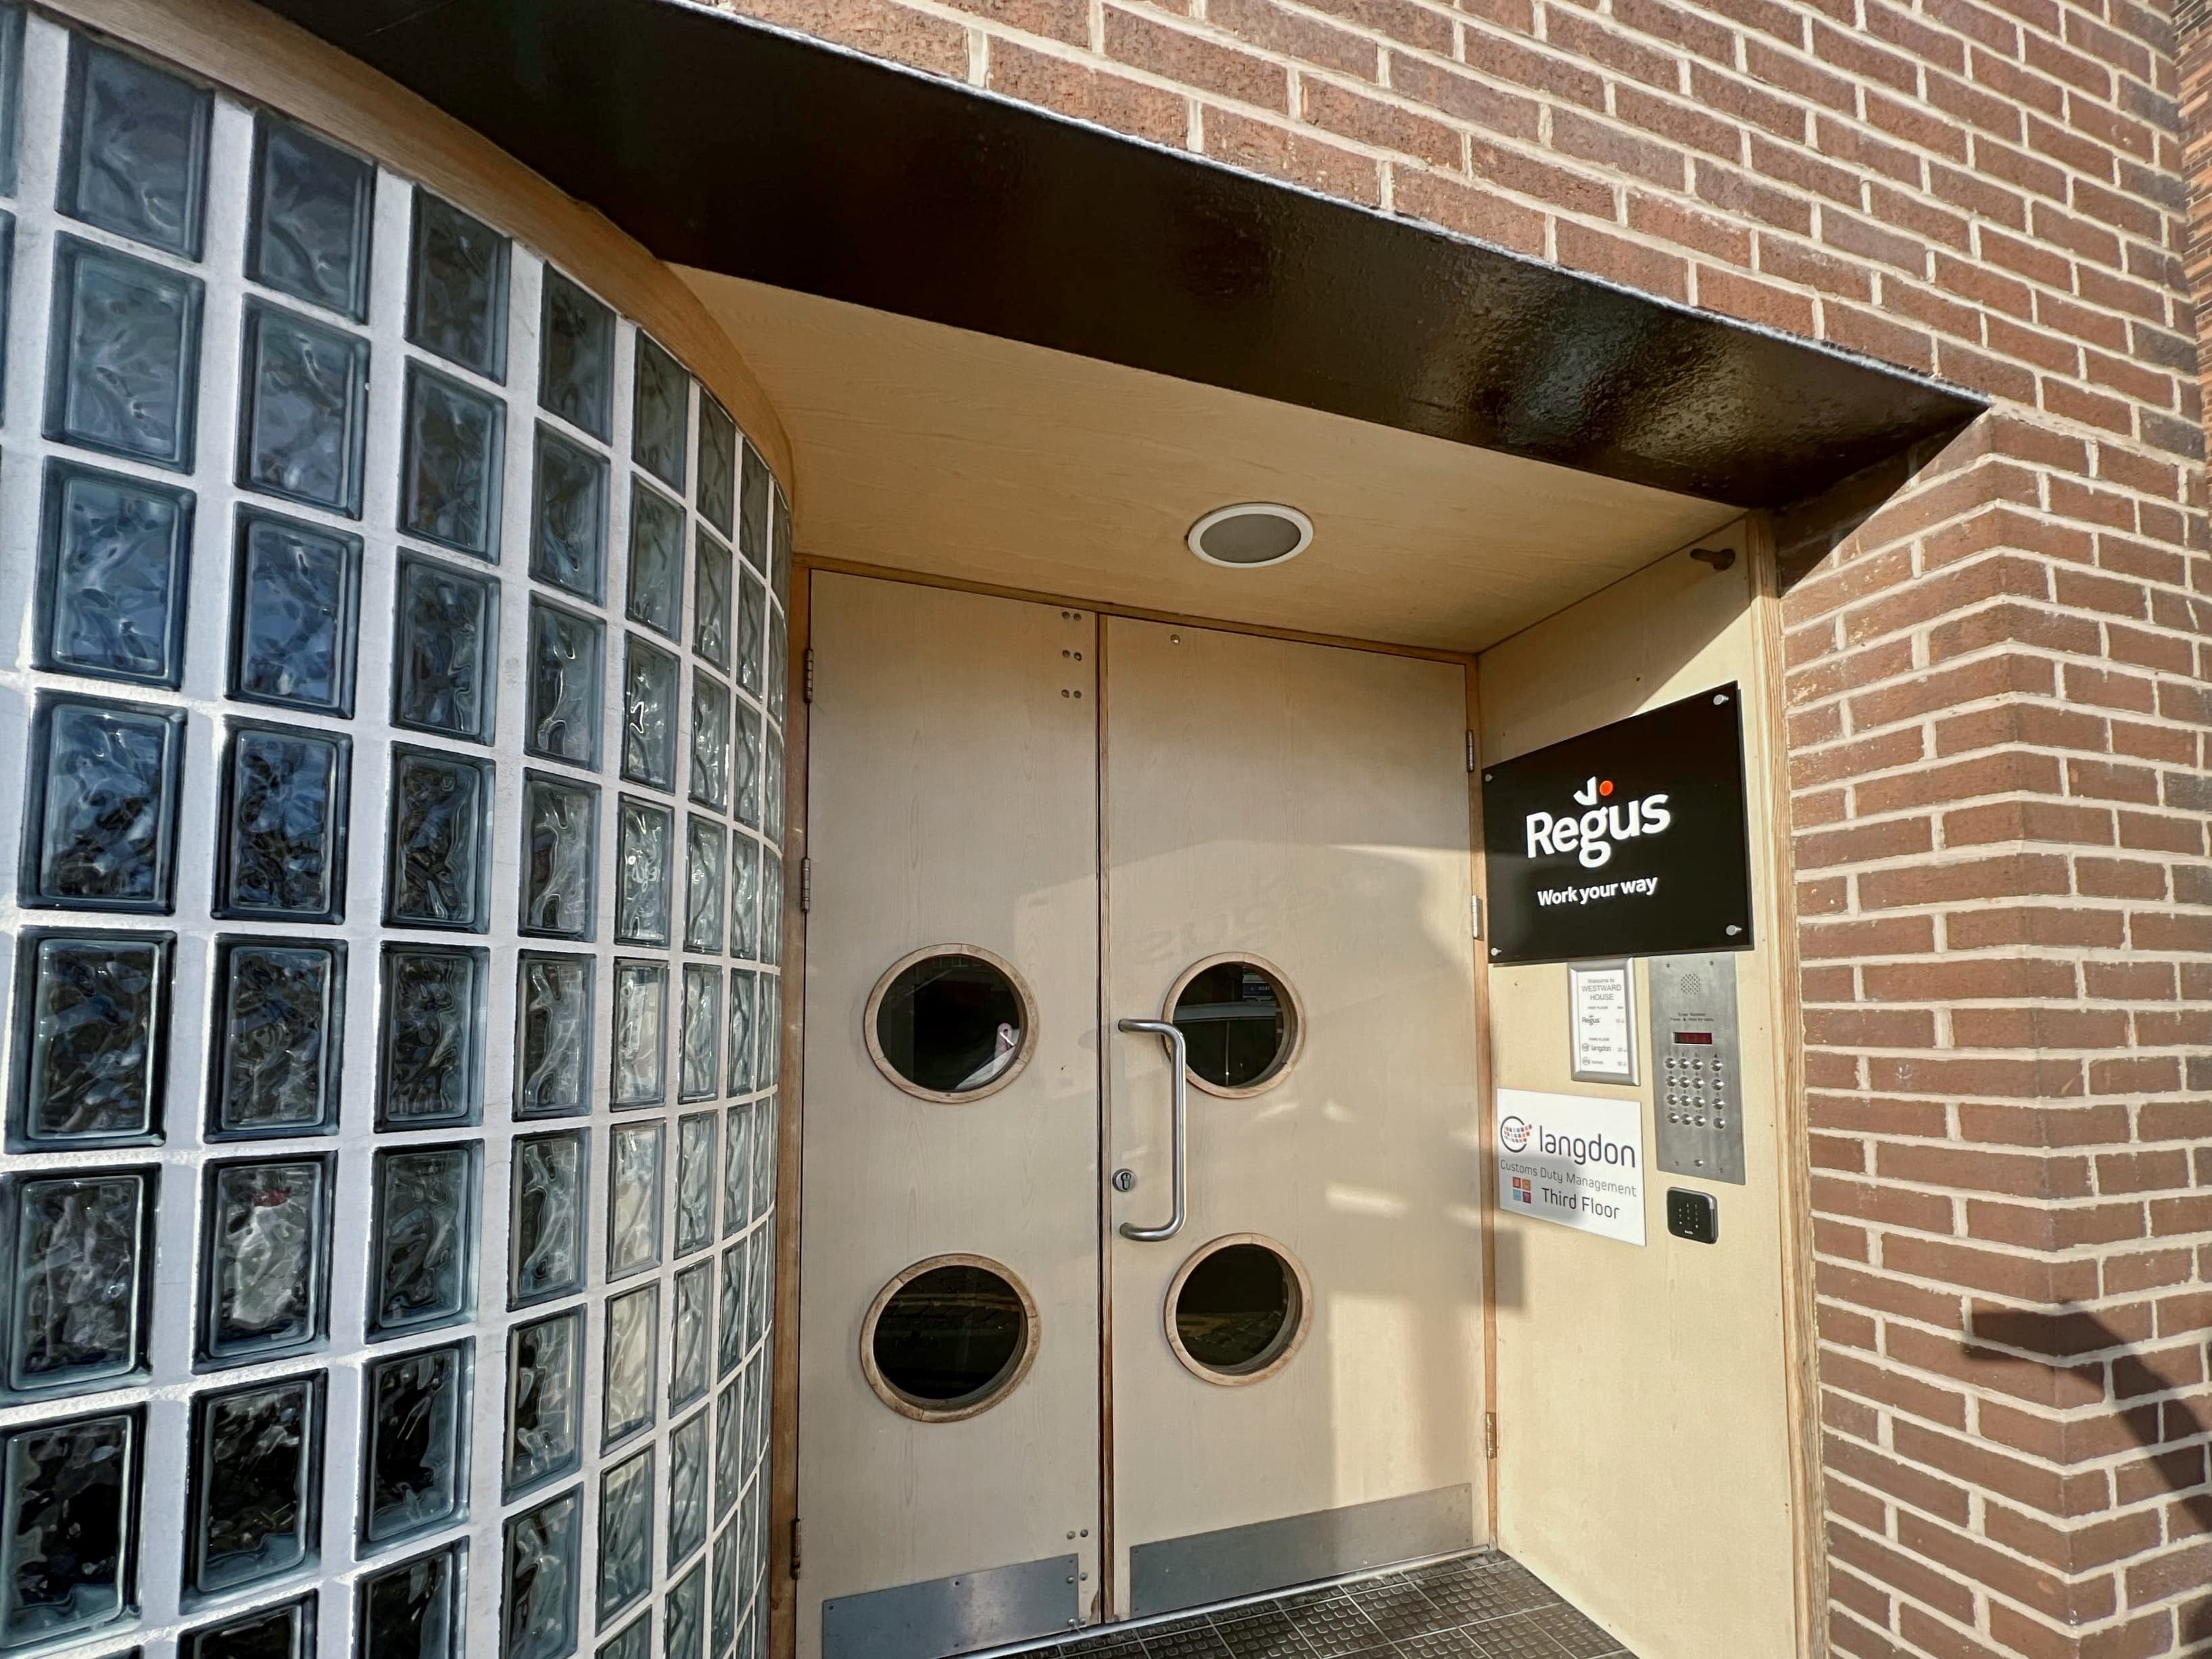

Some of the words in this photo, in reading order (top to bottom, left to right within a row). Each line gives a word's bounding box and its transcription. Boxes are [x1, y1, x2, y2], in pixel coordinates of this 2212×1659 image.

[1526, 794, 1670, 868] Regus
[1537, 886, 1578, 906] Work
[1579, 882, 1618, 905] your
[1620, 876, 1658, 896] way
[1581, 984, 1622, 992] WESTWARD
[1581, 1016, 1600, 1026] Regus
[1539, 1125, 1636, 1168] langdon
[1500, 1159, 1538, 1177] Customs
[1540, 1167, 1563, 1184] Duty
[1566, 1172, 1637, 1197] Management
[1541, 1187, 1577, 1209] Third
[1581, 1196, 1620, 1220] Floor
